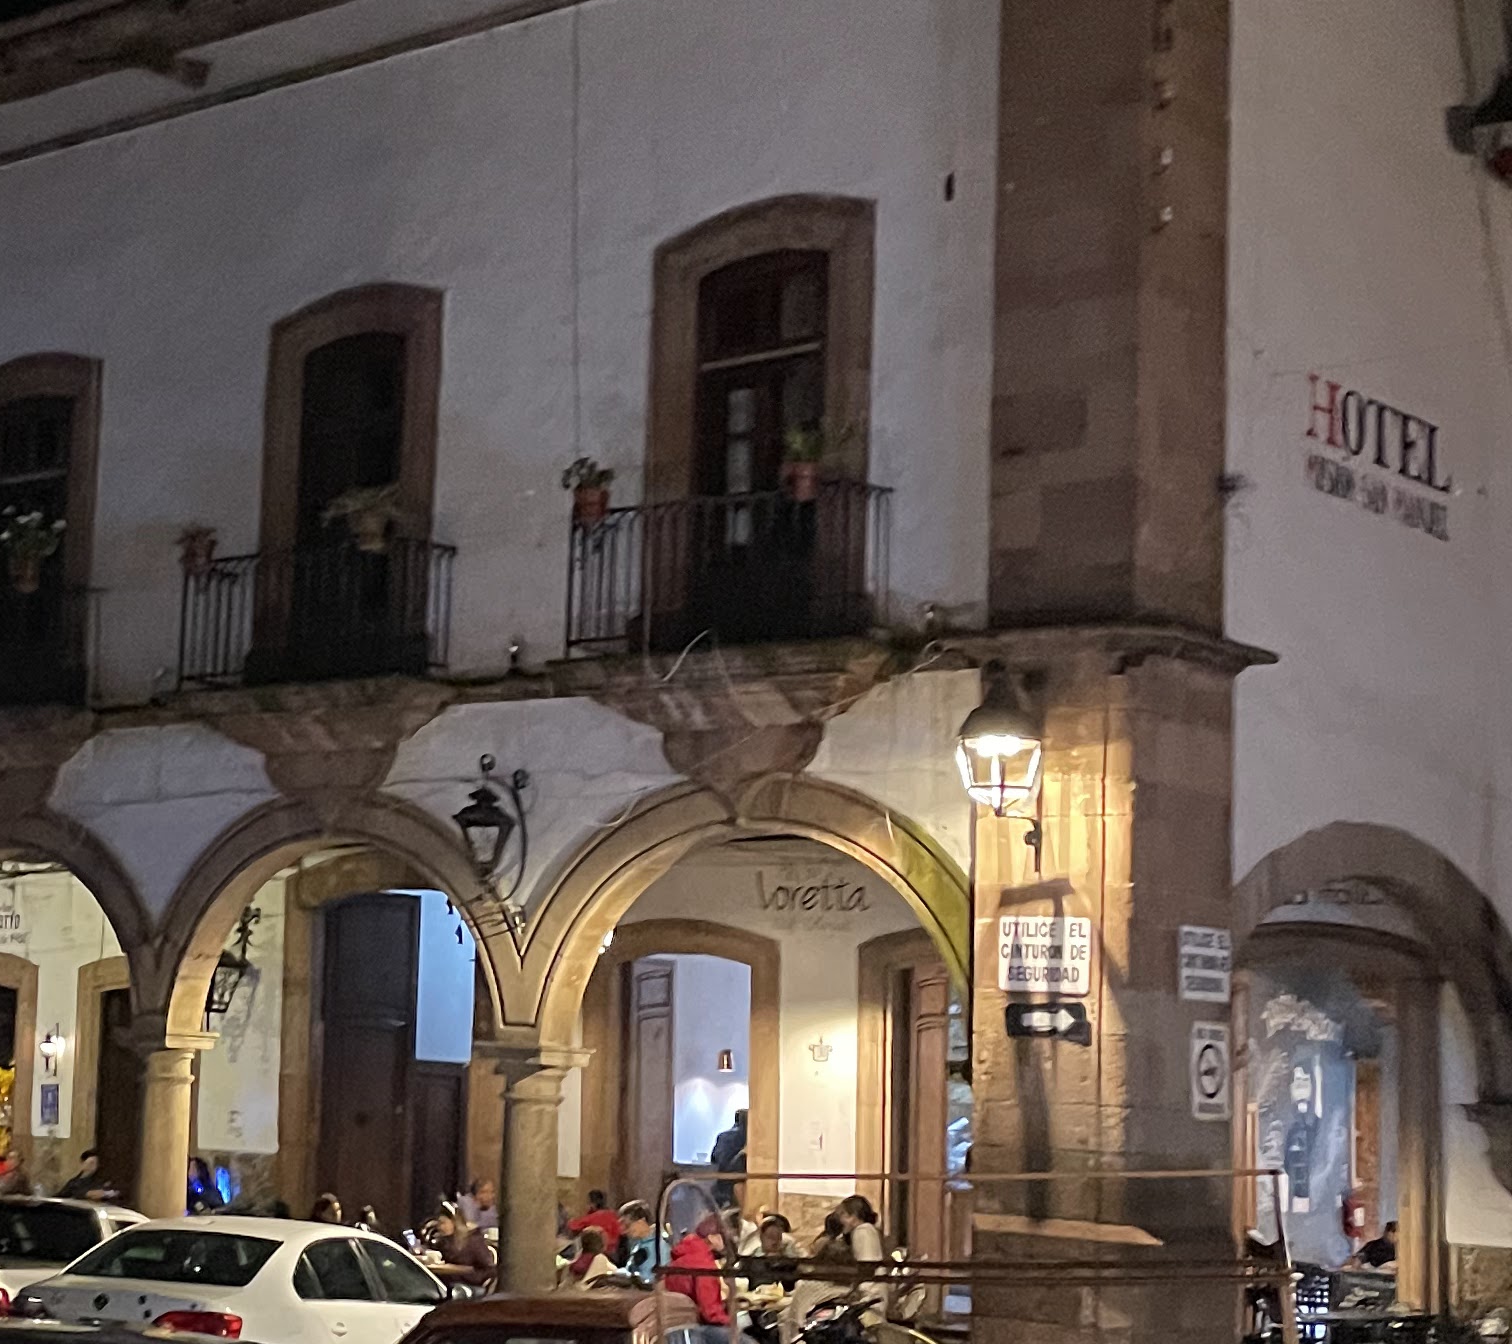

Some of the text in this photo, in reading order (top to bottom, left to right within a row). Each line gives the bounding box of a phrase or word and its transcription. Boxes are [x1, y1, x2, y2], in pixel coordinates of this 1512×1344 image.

[1305, 373, 1453, 494] HOTEL
[1002, 921, 1087, 938] UTILICE EL
[1000, 943, 1088, 961] CINTURON DE
[1008, 966, 1080, 983] SEGURIDAD
